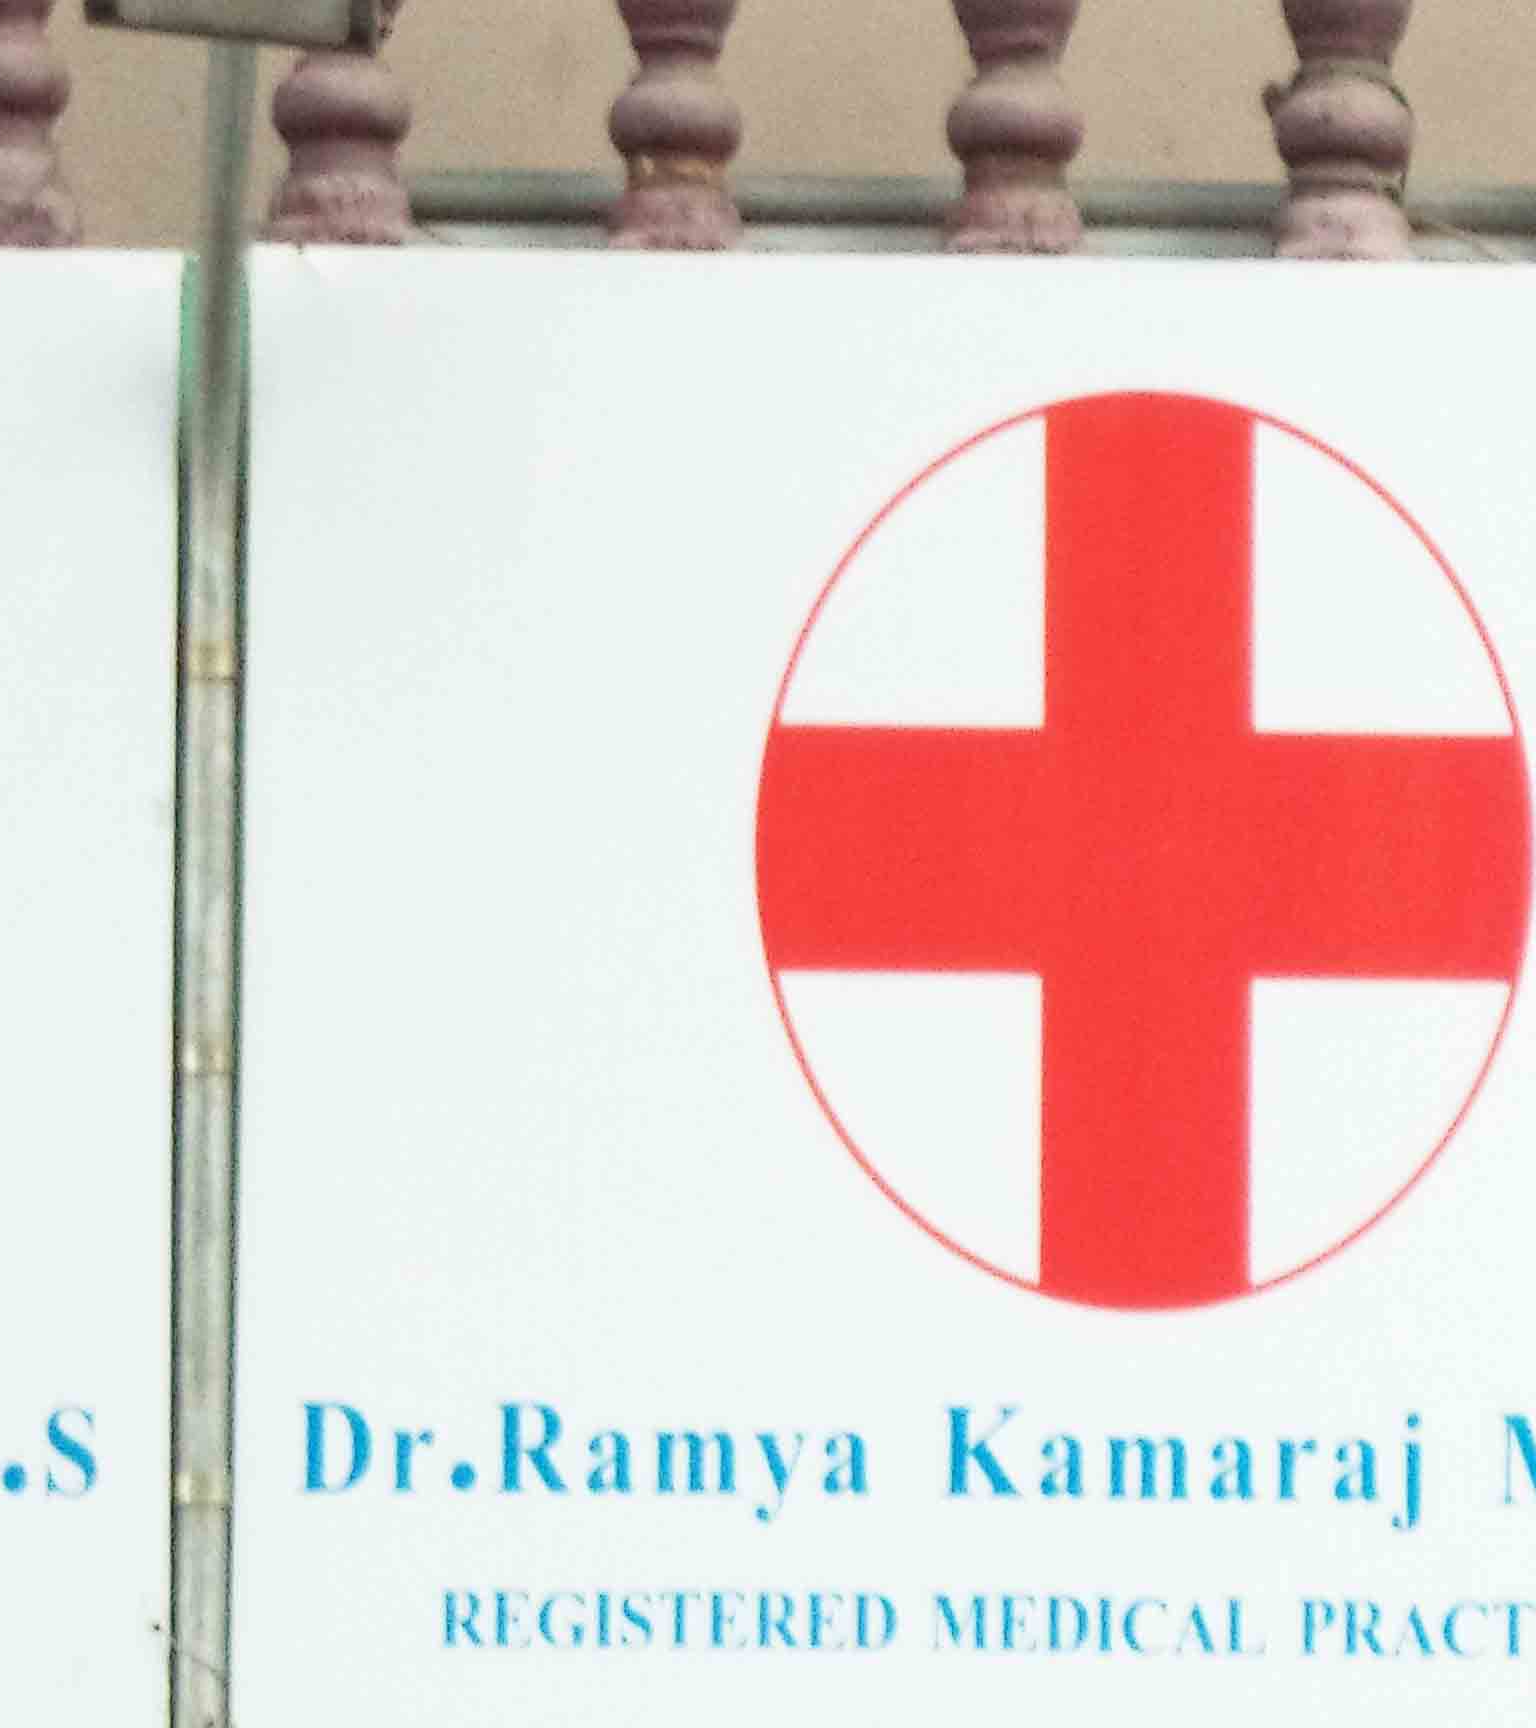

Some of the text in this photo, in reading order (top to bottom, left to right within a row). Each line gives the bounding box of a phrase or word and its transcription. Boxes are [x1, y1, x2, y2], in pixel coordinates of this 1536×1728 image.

[300, 1400, 870, 1525] Dr.Ramya
[944, 1405, 1425, 1532] Kamaraj
[441, 1589, 900, 1651] REGISTERED
[932, 1592, 1265, 1656] MEDICAL
